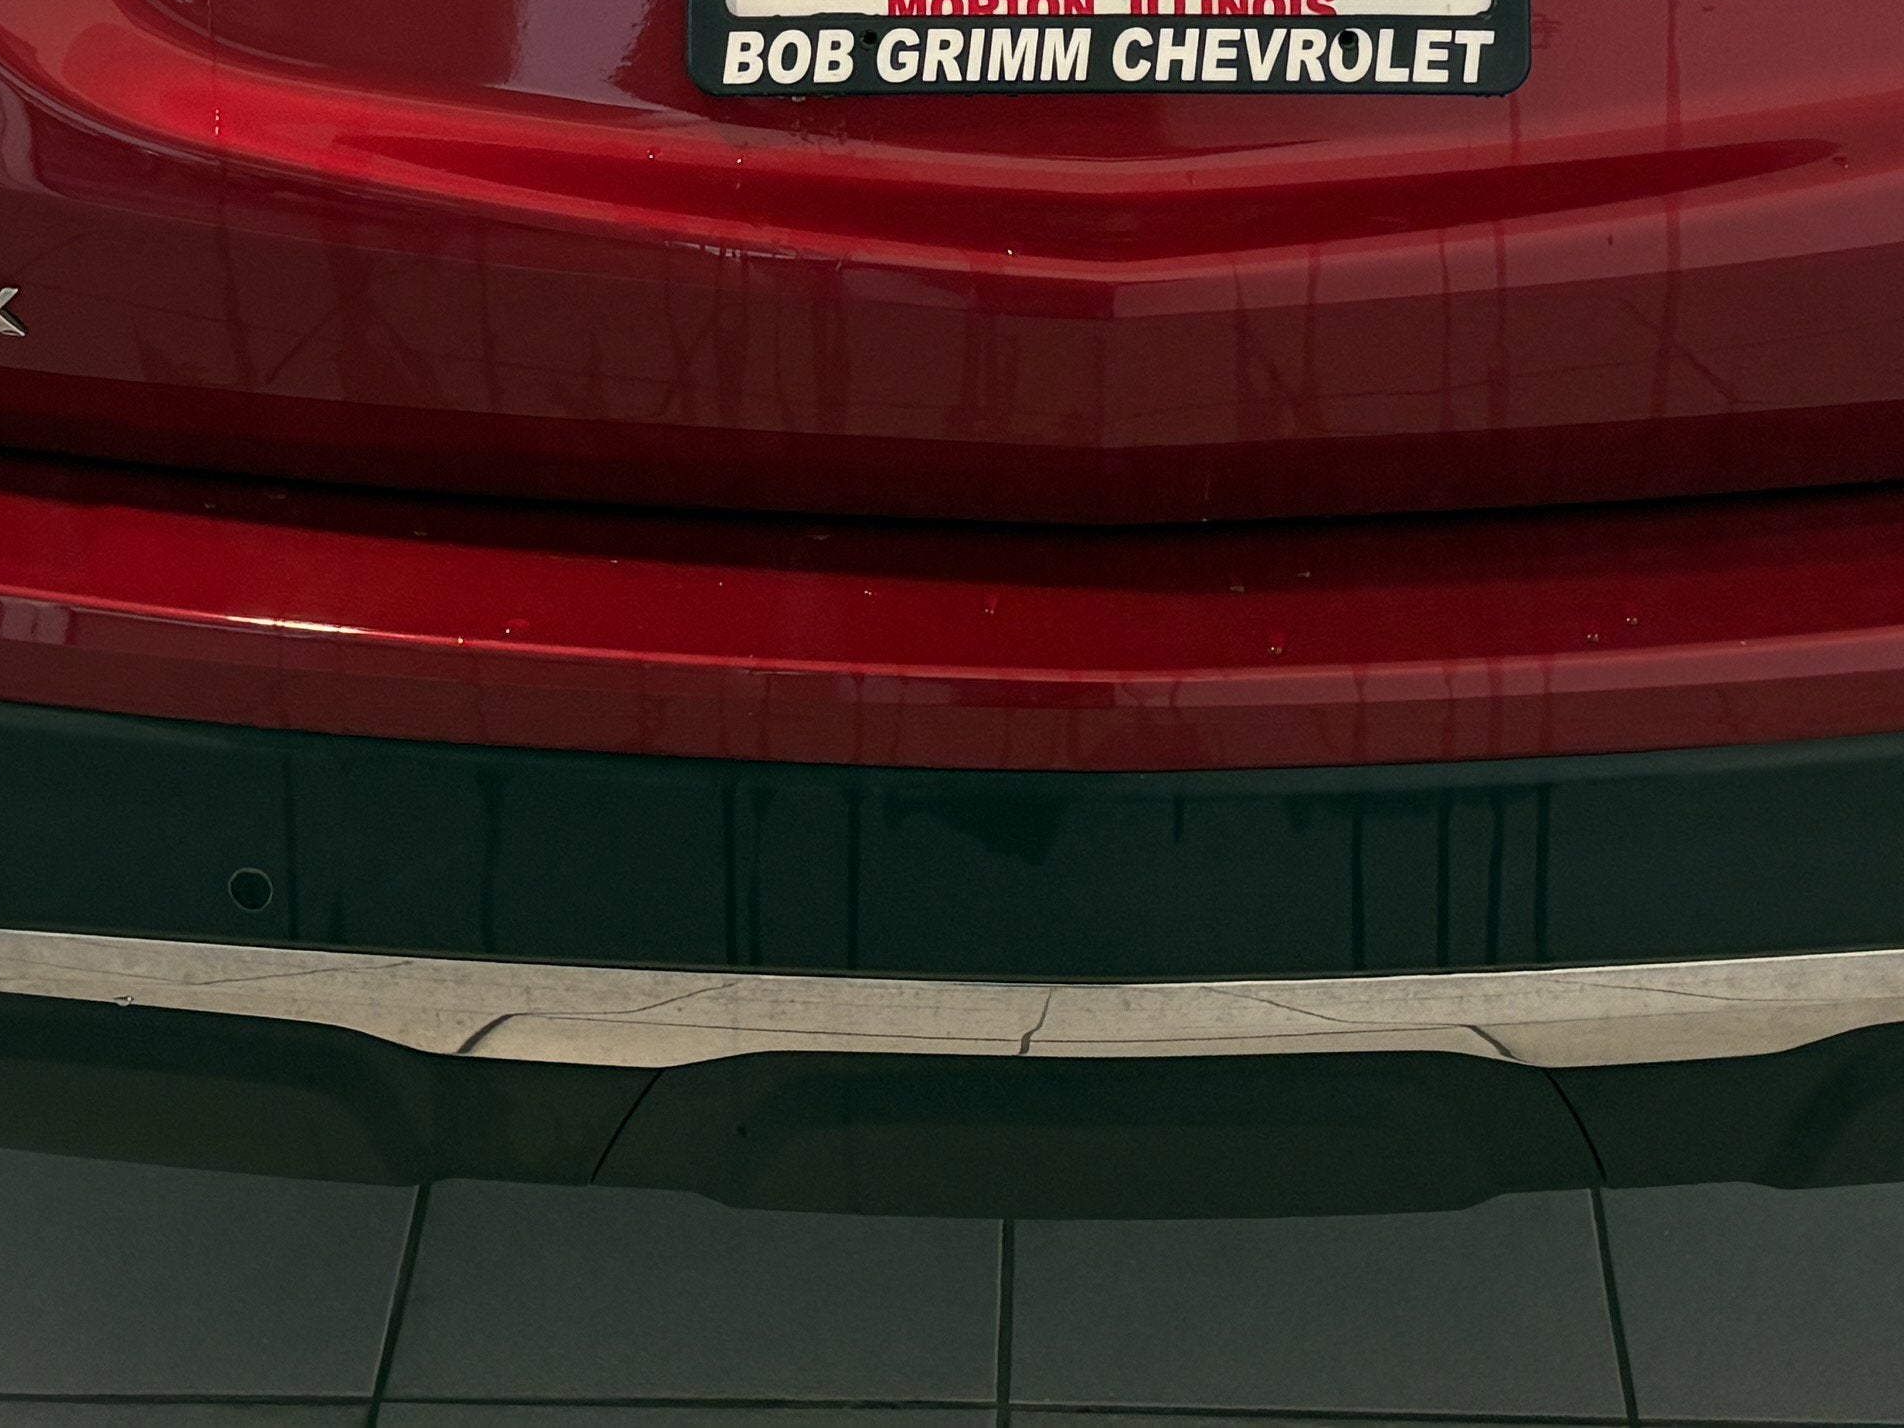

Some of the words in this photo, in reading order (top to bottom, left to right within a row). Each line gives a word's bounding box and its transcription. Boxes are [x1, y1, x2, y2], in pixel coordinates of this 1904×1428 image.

[721, 29, 855, 85] BOB
[875, 28, 1092, 84] GRIMM
[1111, 26, 1496, 84] CHEVROLET
